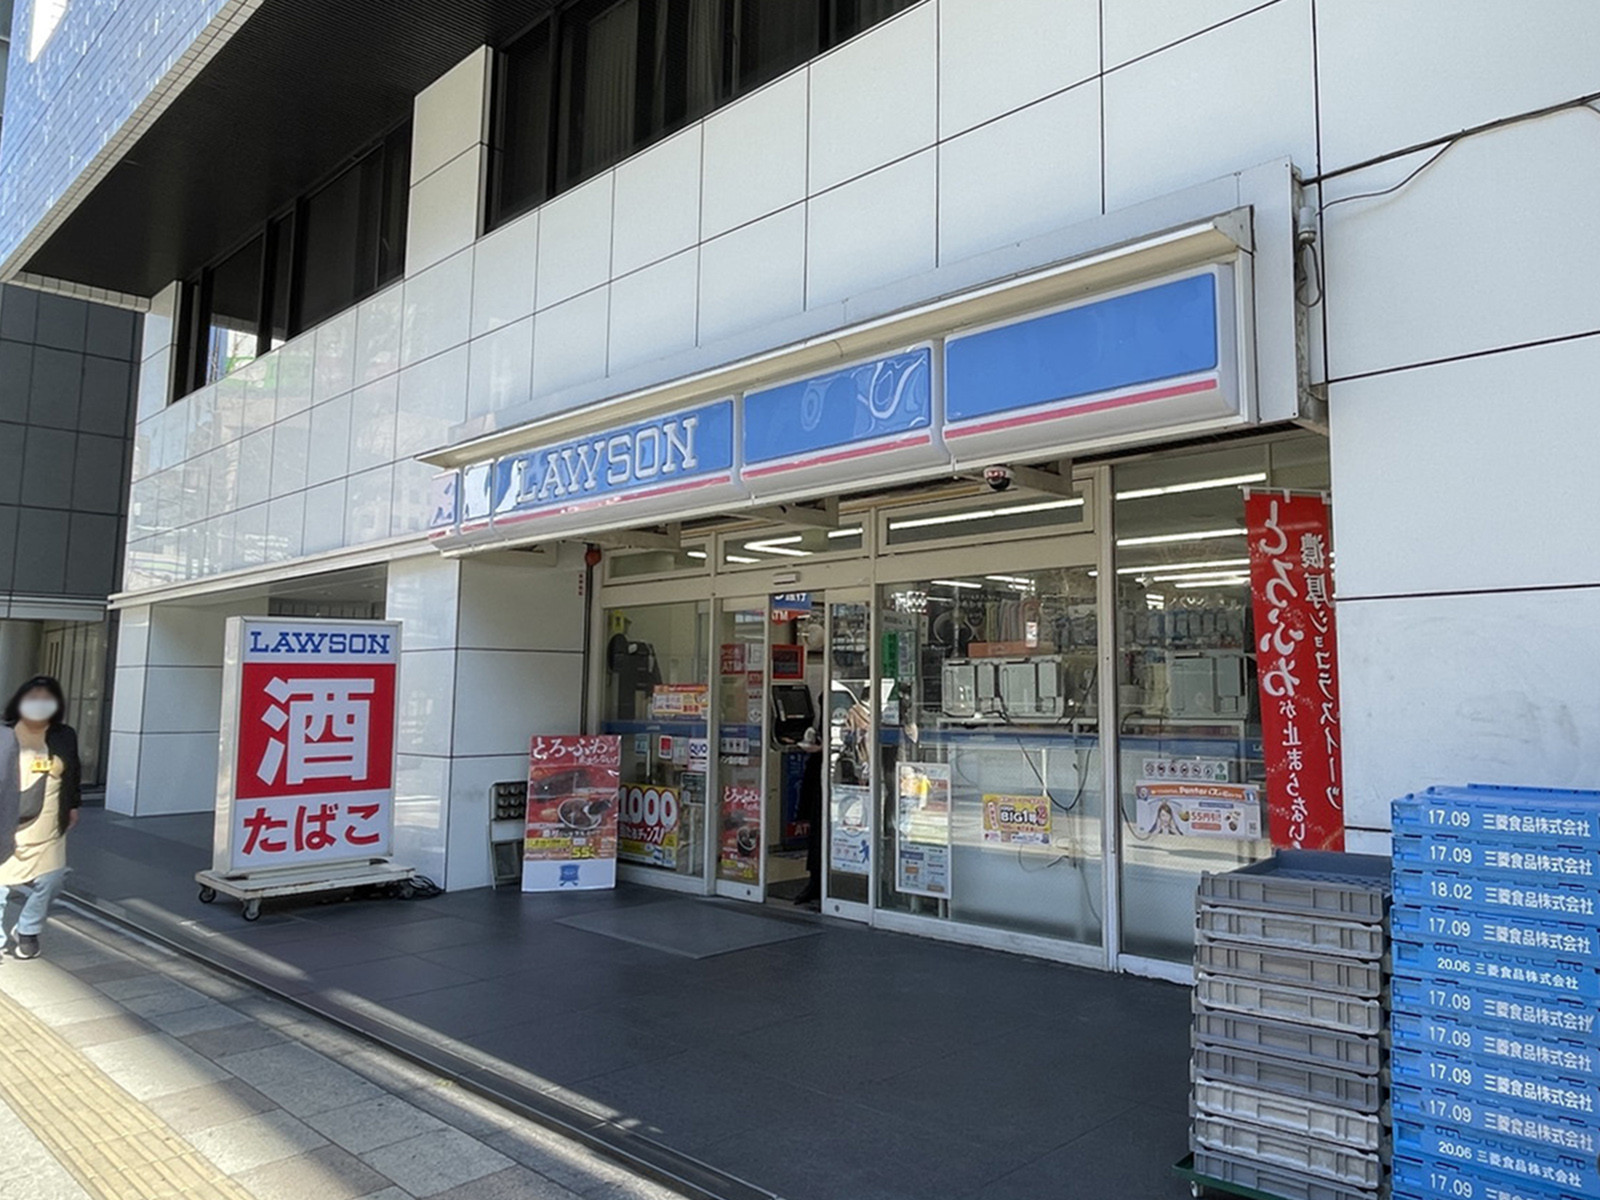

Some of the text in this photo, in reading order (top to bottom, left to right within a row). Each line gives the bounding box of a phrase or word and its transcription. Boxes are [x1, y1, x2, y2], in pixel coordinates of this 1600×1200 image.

[517, 415, 699, 504] LAWSON
[250, 631, 390, 654] LAWSON
[256, 676, 375, 786] 酒
[242, 803, 380, 855] たばこ
[619, 786, 678, 830] 1000
[1428, 810, 1591, 837] 17.09 三菱食品株式会社
[1430, 846, 1593, 876] 17.09 三菱食品株式会社
[1430, 881, 1594, 915] 18.02 三菱食品株式会社
[1429, 918, 1591, 954] 17.09 三菱食品株式会社
[1437, 958, 1579, 989] 20.06 三菱食品株式会社
[1429, 990, 1593, 1033] 17.09 三菱食品株式会社
[1429, 1026, 1592, 1072] 17.09 三菱食品株式会社
[1429, 1063, 1593, 1112] 17.09 三菱食品株式会社
[1429, 1100, 1594, 1152] 17.09 三菱食品株式会社
[1430, 1173, 1473, 1198] 17.09
[1438, 1141, 1582, 1188] 20.06 三菱食品株式会社
